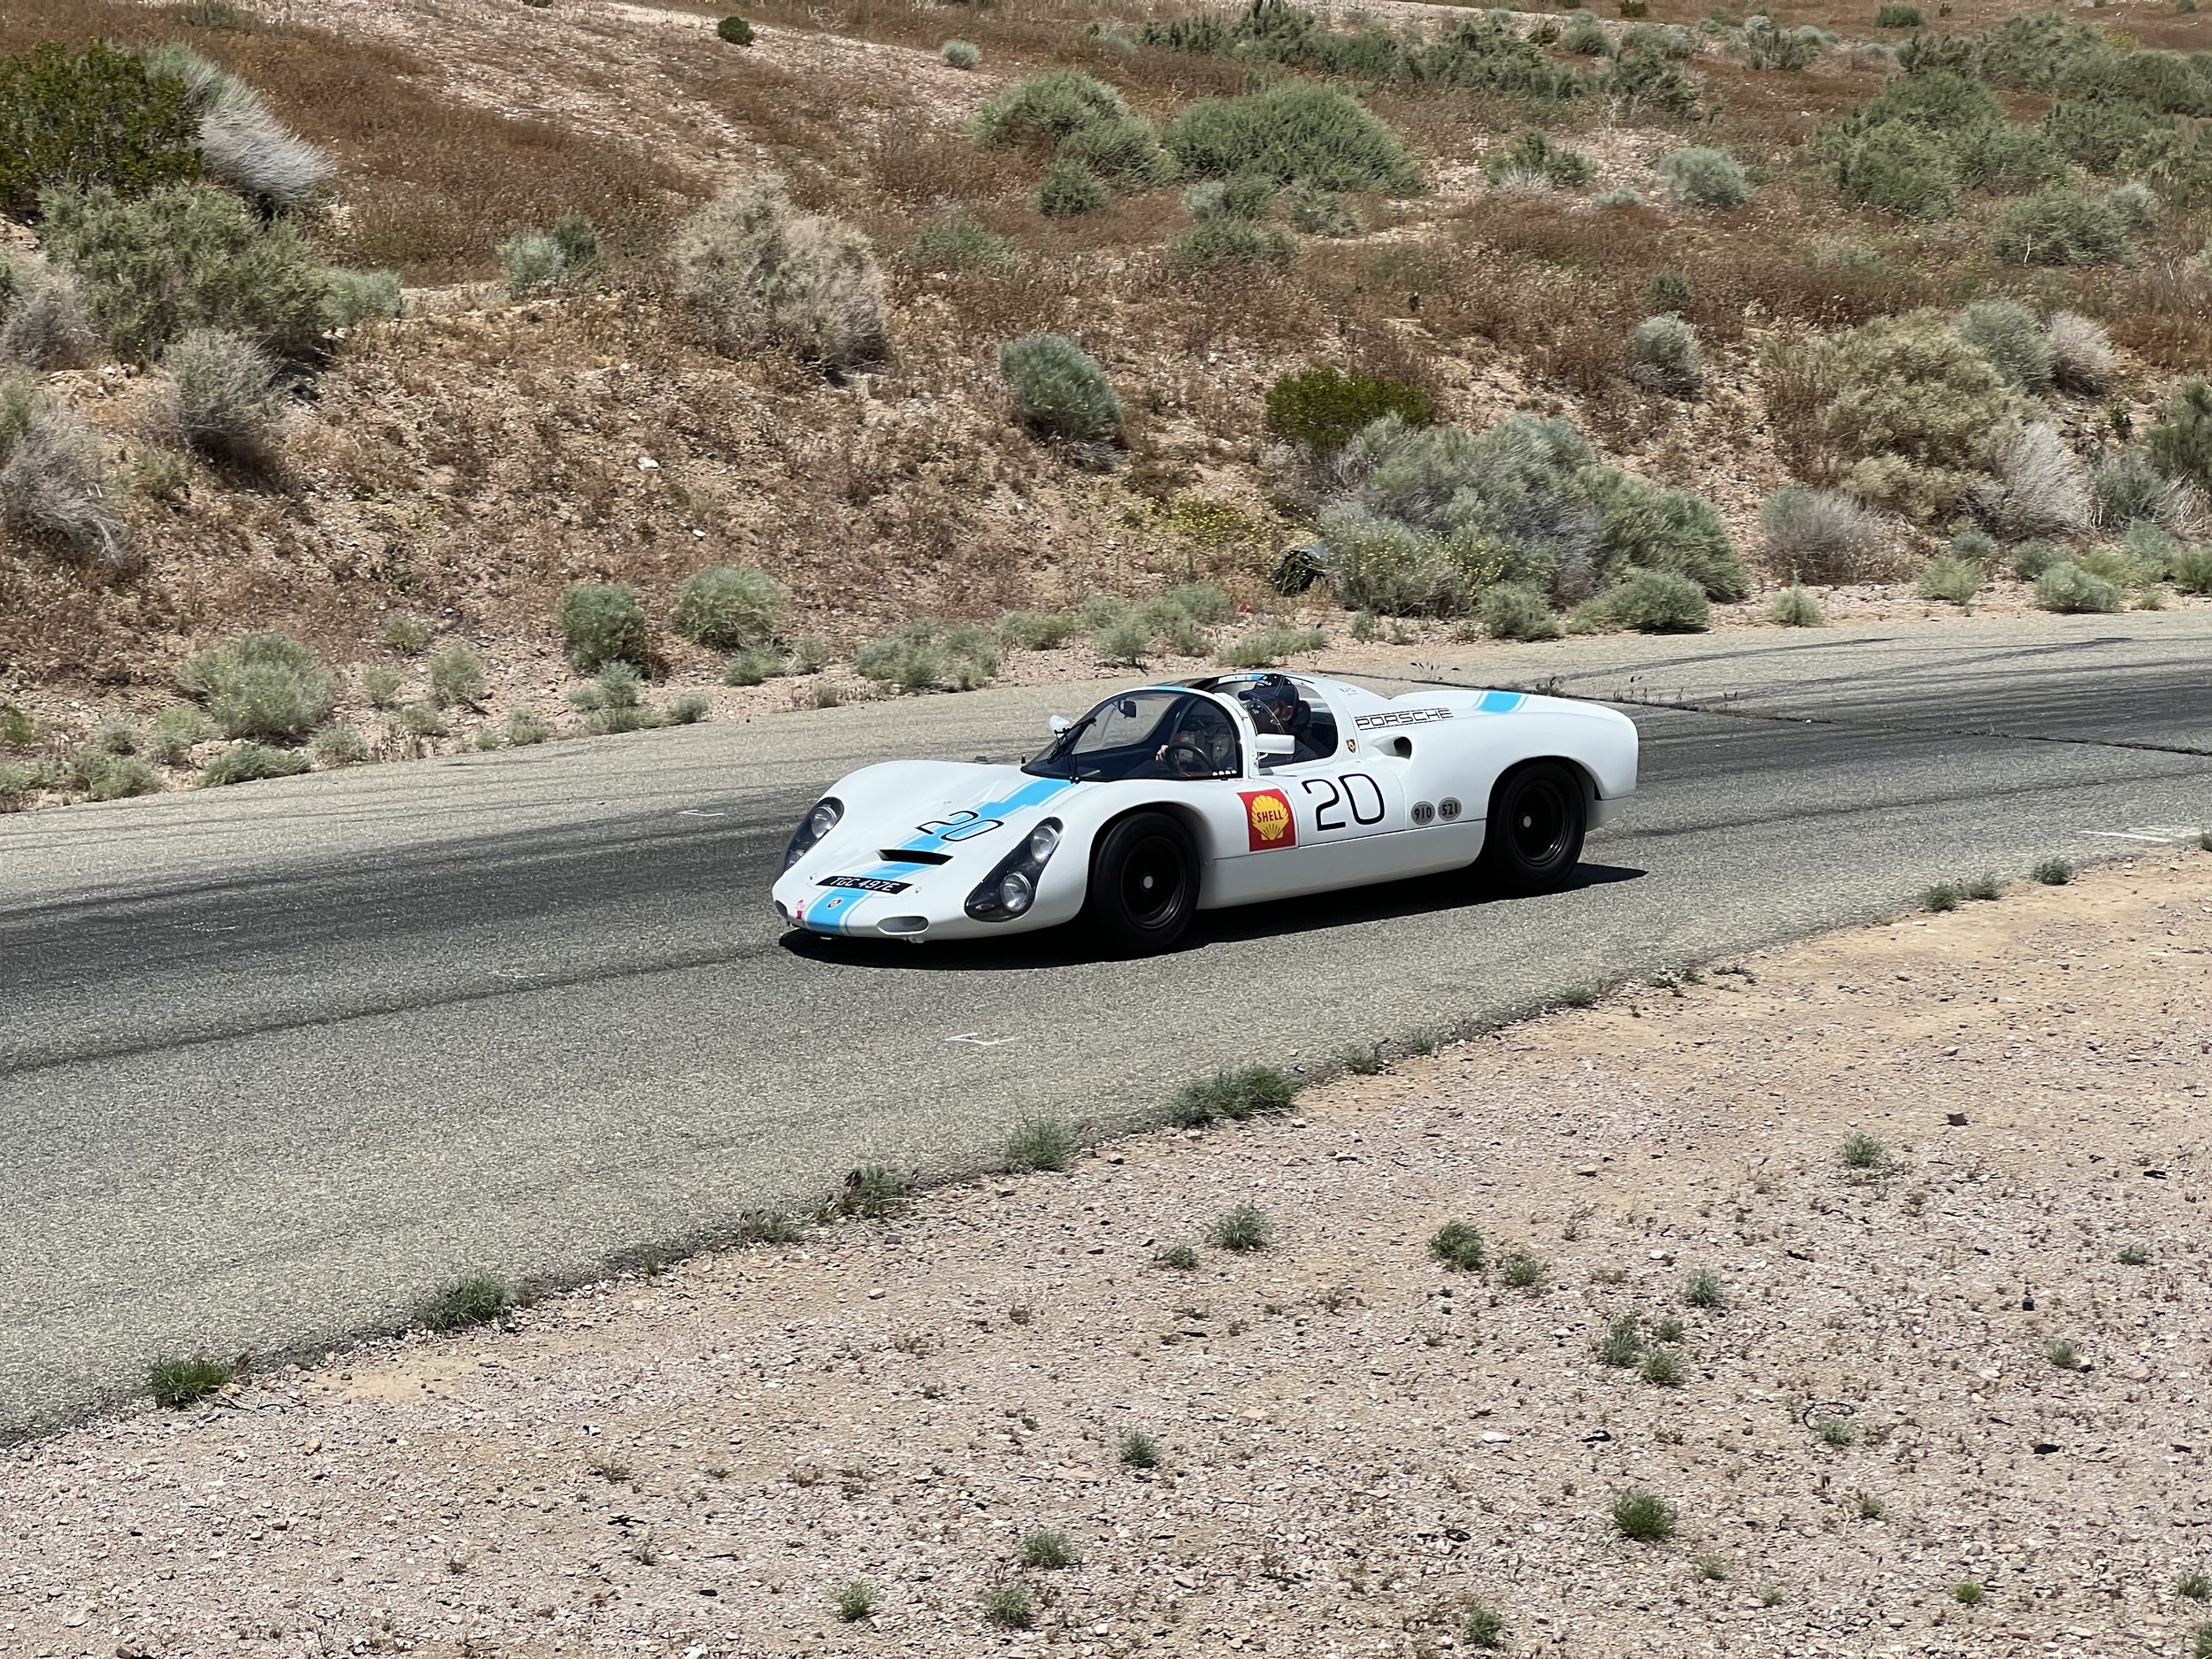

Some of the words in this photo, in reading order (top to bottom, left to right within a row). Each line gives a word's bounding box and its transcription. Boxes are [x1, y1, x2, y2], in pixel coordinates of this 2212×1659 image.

[1355, 709, 1454, 728] PORSCHE
[1301, 773, 1385, 832] 20
[1442, 803, 1458, 816] 521
[1256, 809, 1284, 824] SHELL
[1414, 807, 1432, 820] 910
[915, 810, 1004, 842] 20
[830, 877, 861, 887] TGC
[859, 879, 901, 892] 497E
